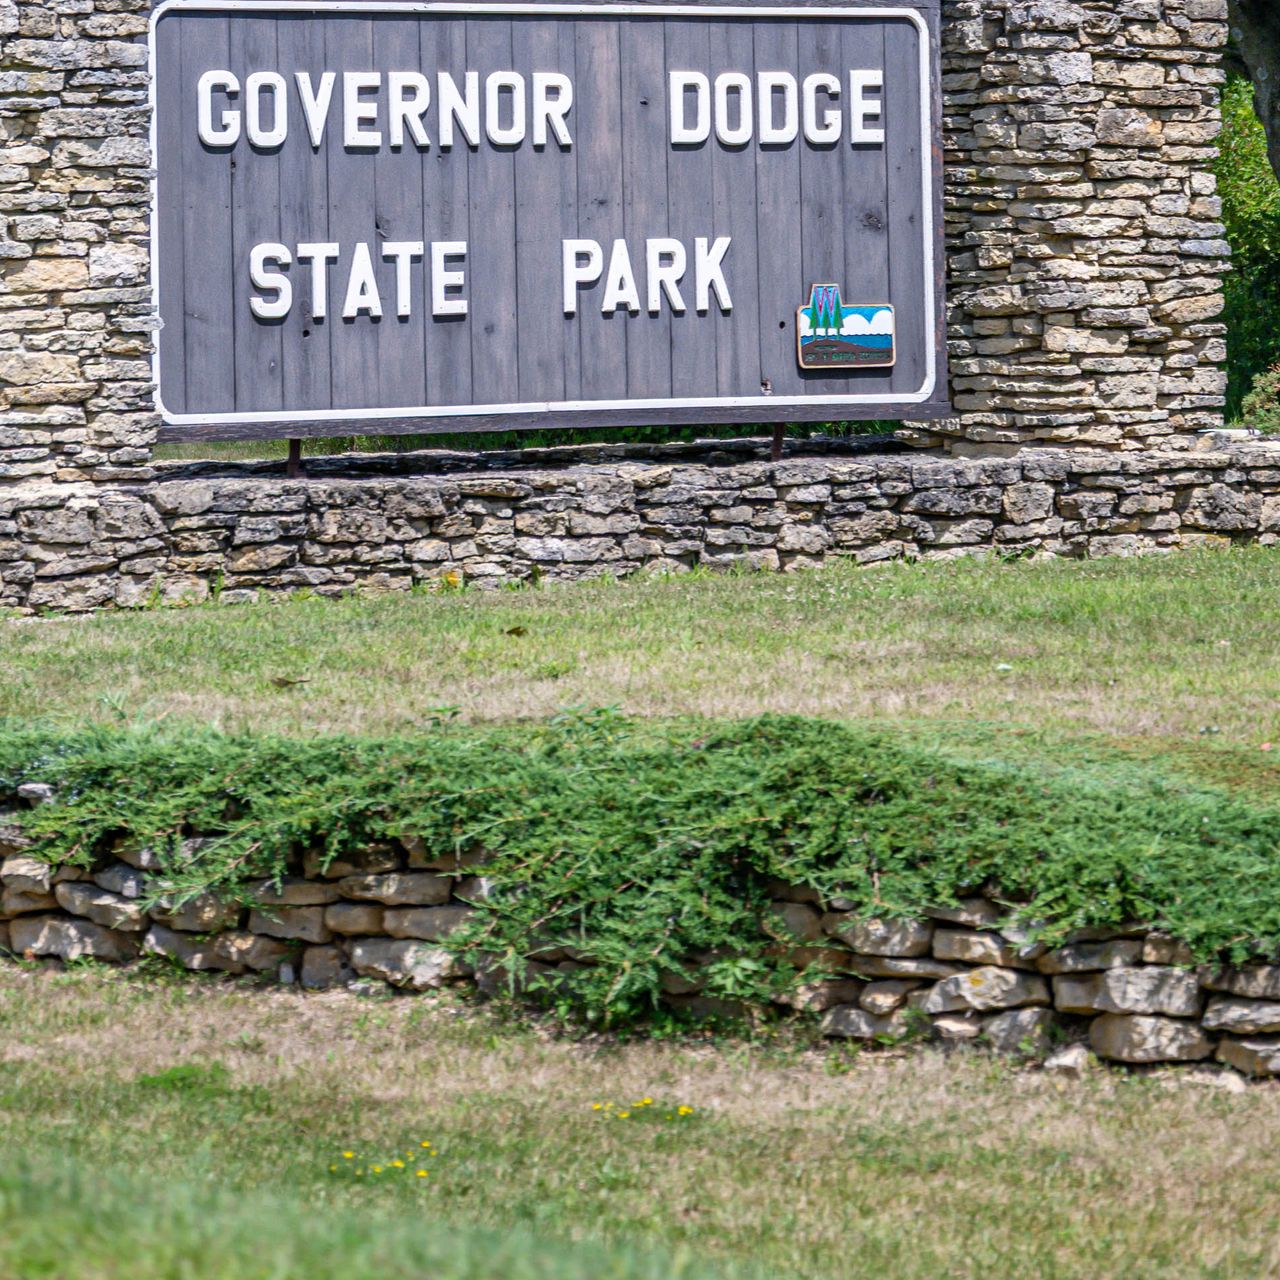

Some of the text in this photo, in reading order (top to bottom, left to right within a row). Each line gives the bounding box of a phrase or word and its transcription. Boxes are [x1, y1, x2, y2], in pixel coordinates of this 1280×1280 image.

[196, 68, 886, 148] GOVERNOR DODGE
[248, 235, 734, 319] STATE PARK
